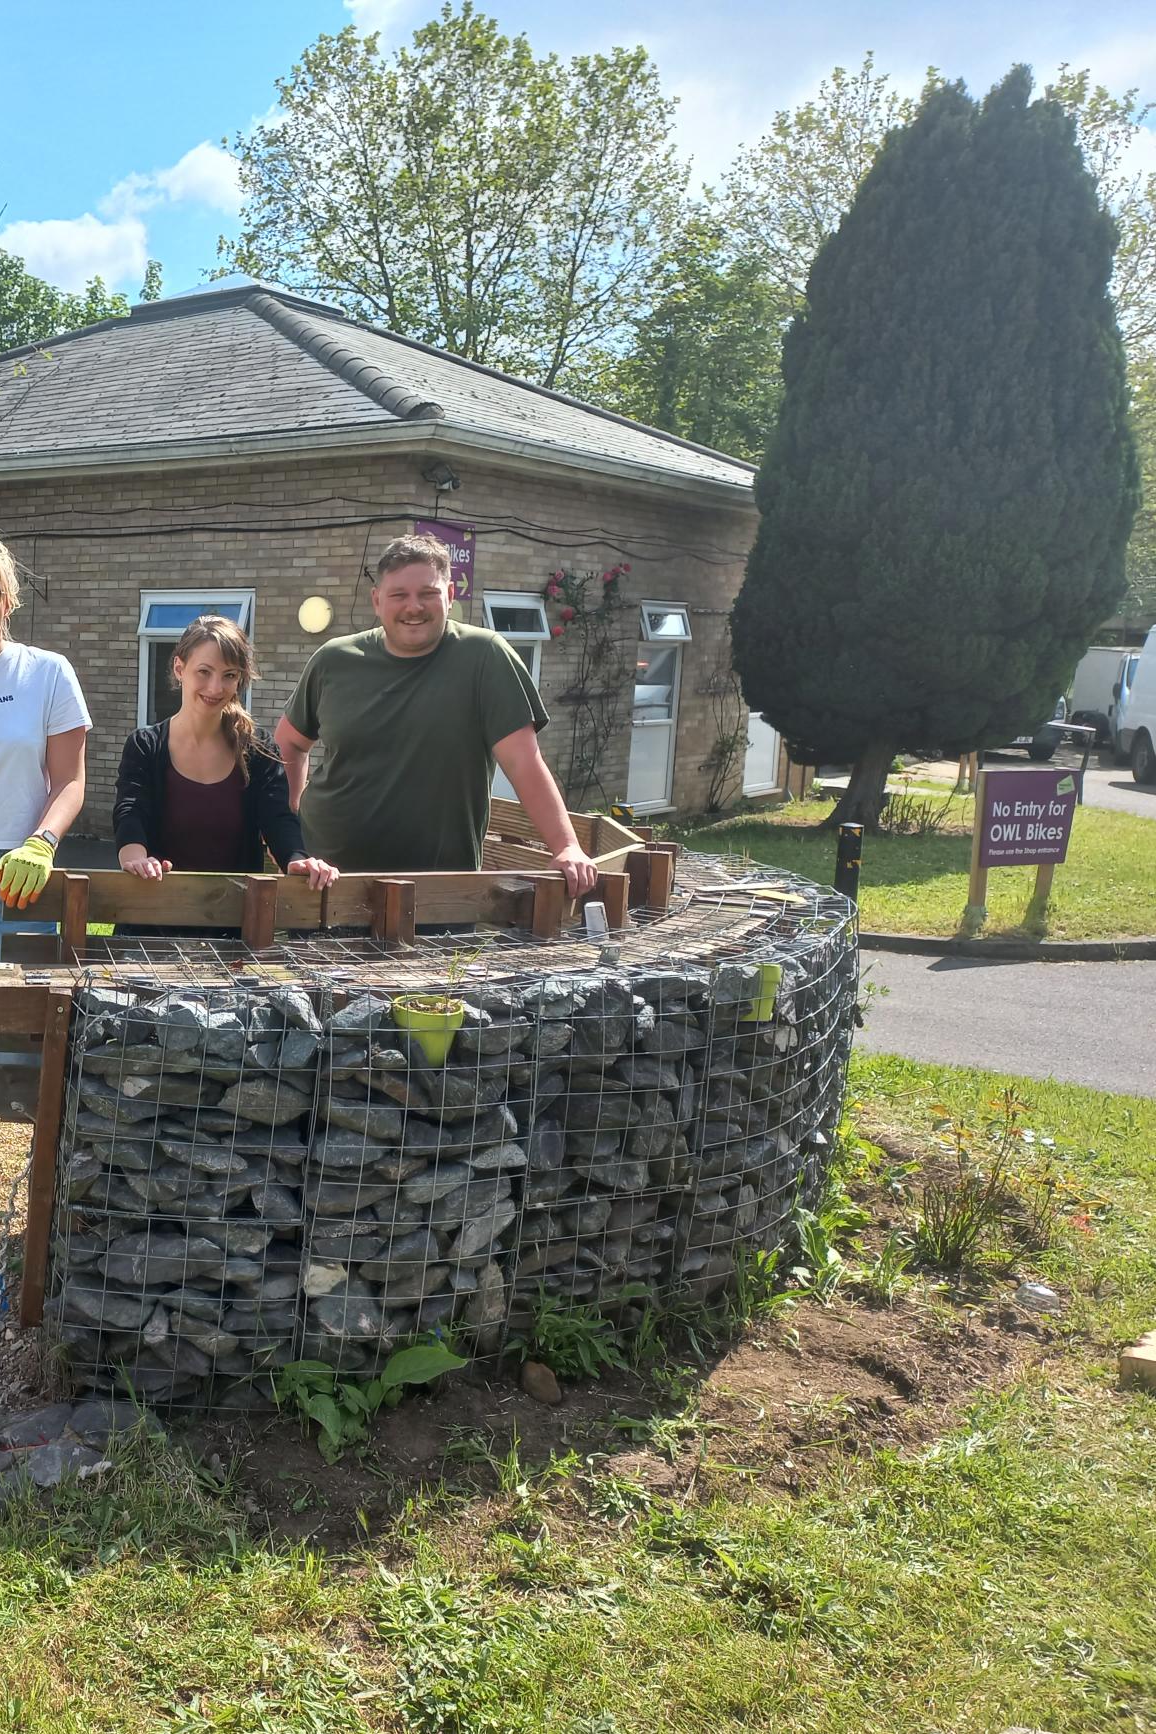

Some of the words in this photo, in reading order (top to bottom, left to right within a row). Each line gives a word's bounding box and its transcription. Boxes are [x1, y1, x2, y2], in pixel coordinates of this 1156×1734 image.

[993, 801, 1010, 817] No
[1014, 801, 1046, 820] Entry
[1049, 801, 1066, 817] for
[990, 823, 1021, 842] OWL
[1026, 823, 1063, 841] Bikes
[989, 848, 1004, 856] Please
[1024, 847, 1037, 855] Shop
